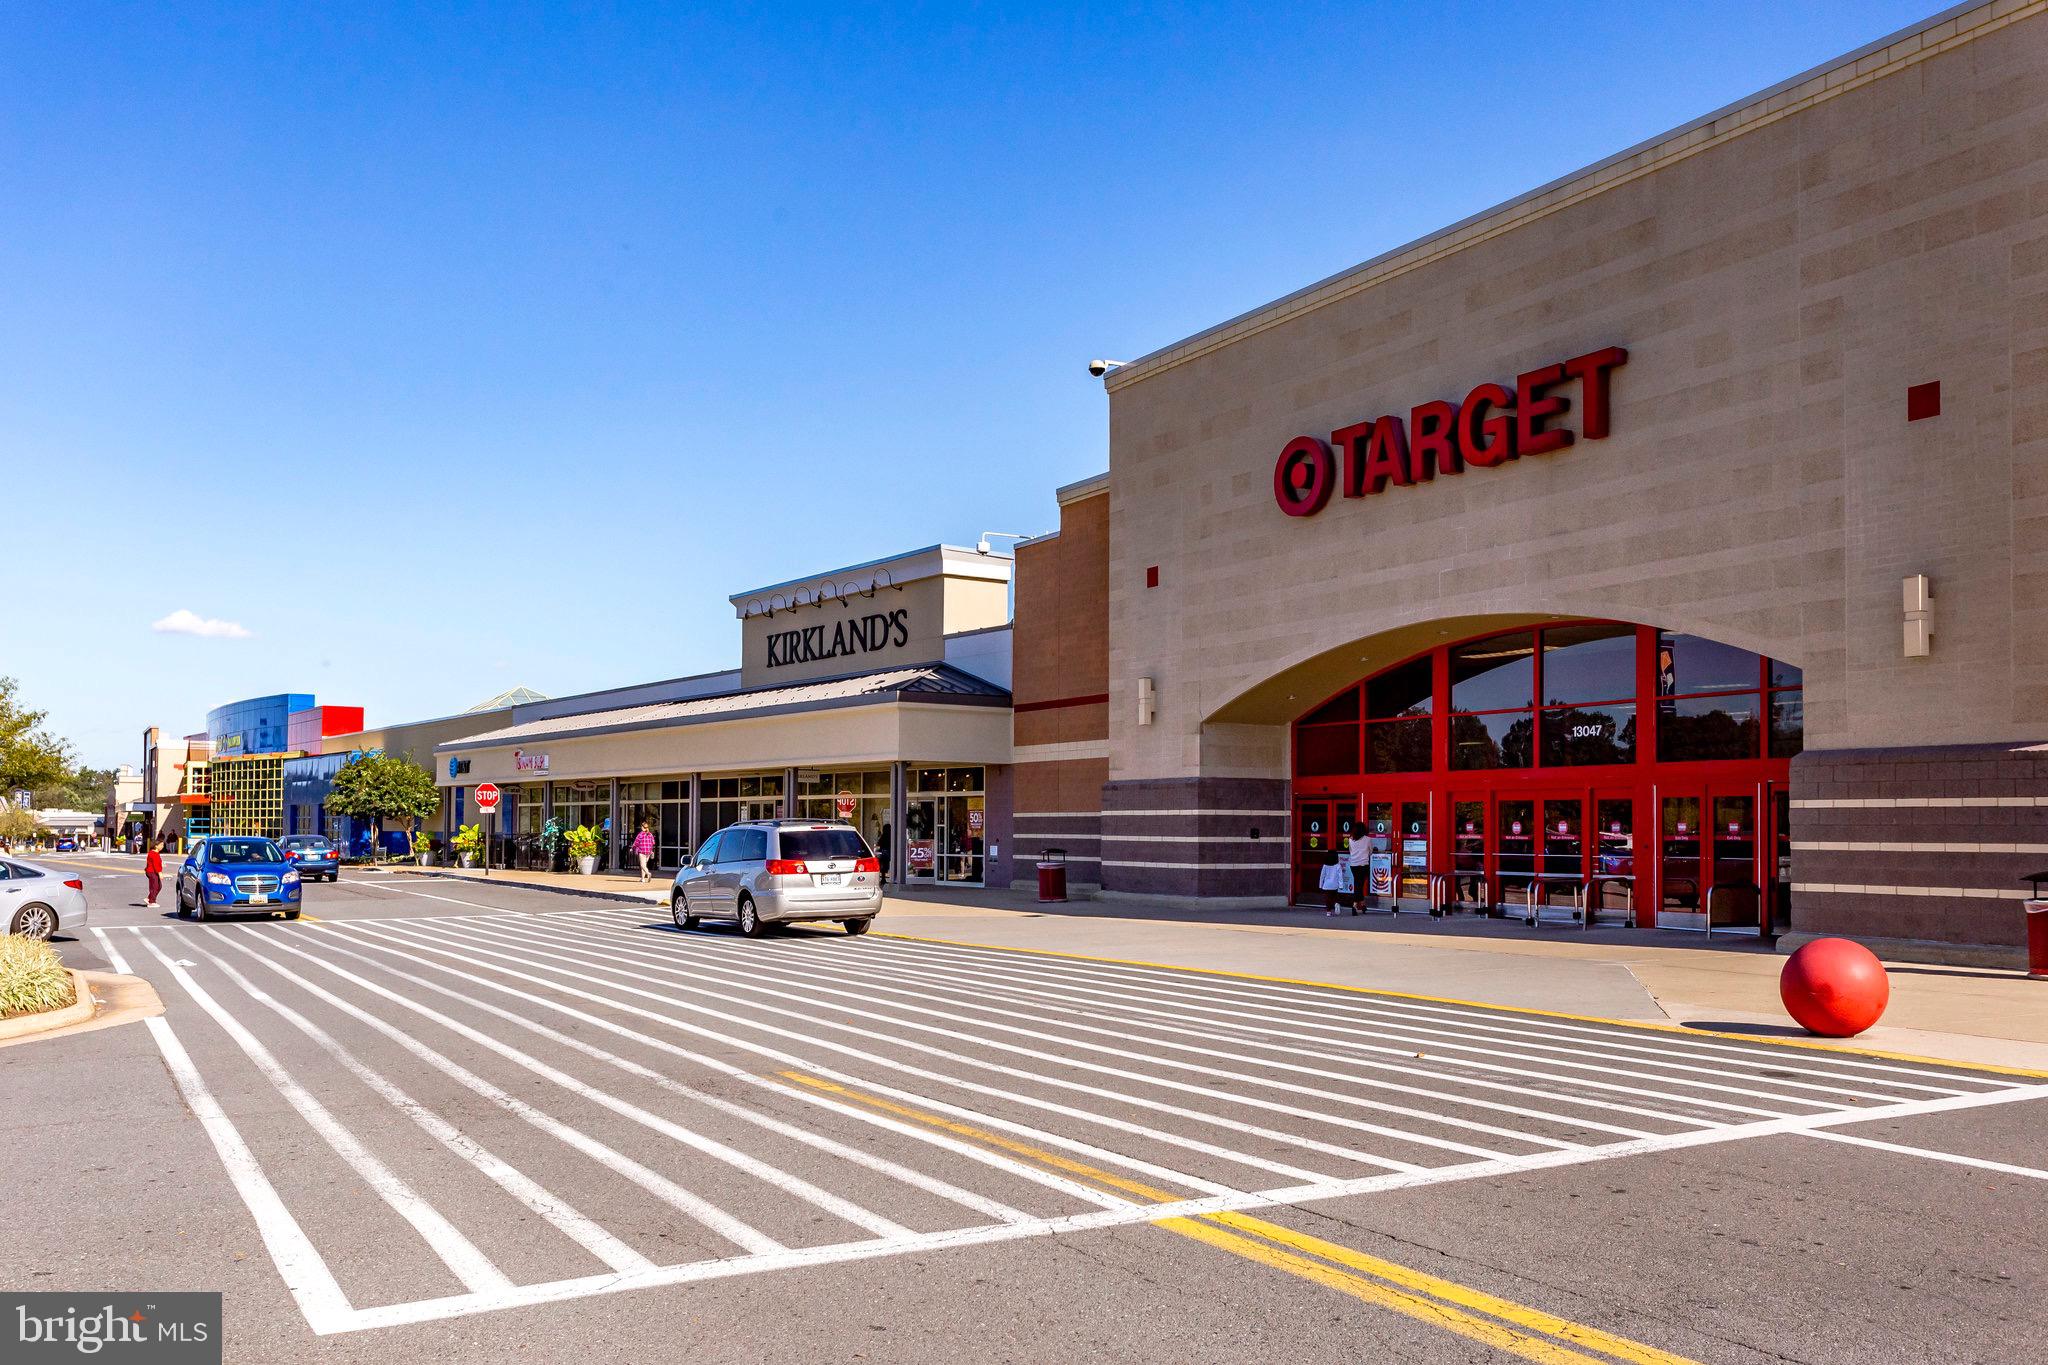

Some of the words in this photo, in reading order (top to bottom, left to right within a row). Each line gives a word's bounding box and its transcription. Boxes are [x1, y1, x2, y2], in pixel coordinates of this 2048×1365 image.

[1331, 346, 1629, 499] TARGET
[766, 609, 908, 668] KIRKLAND'S
[1572, 725, 1602, 737] 13047
[477, 791, 498, 800] STOP
